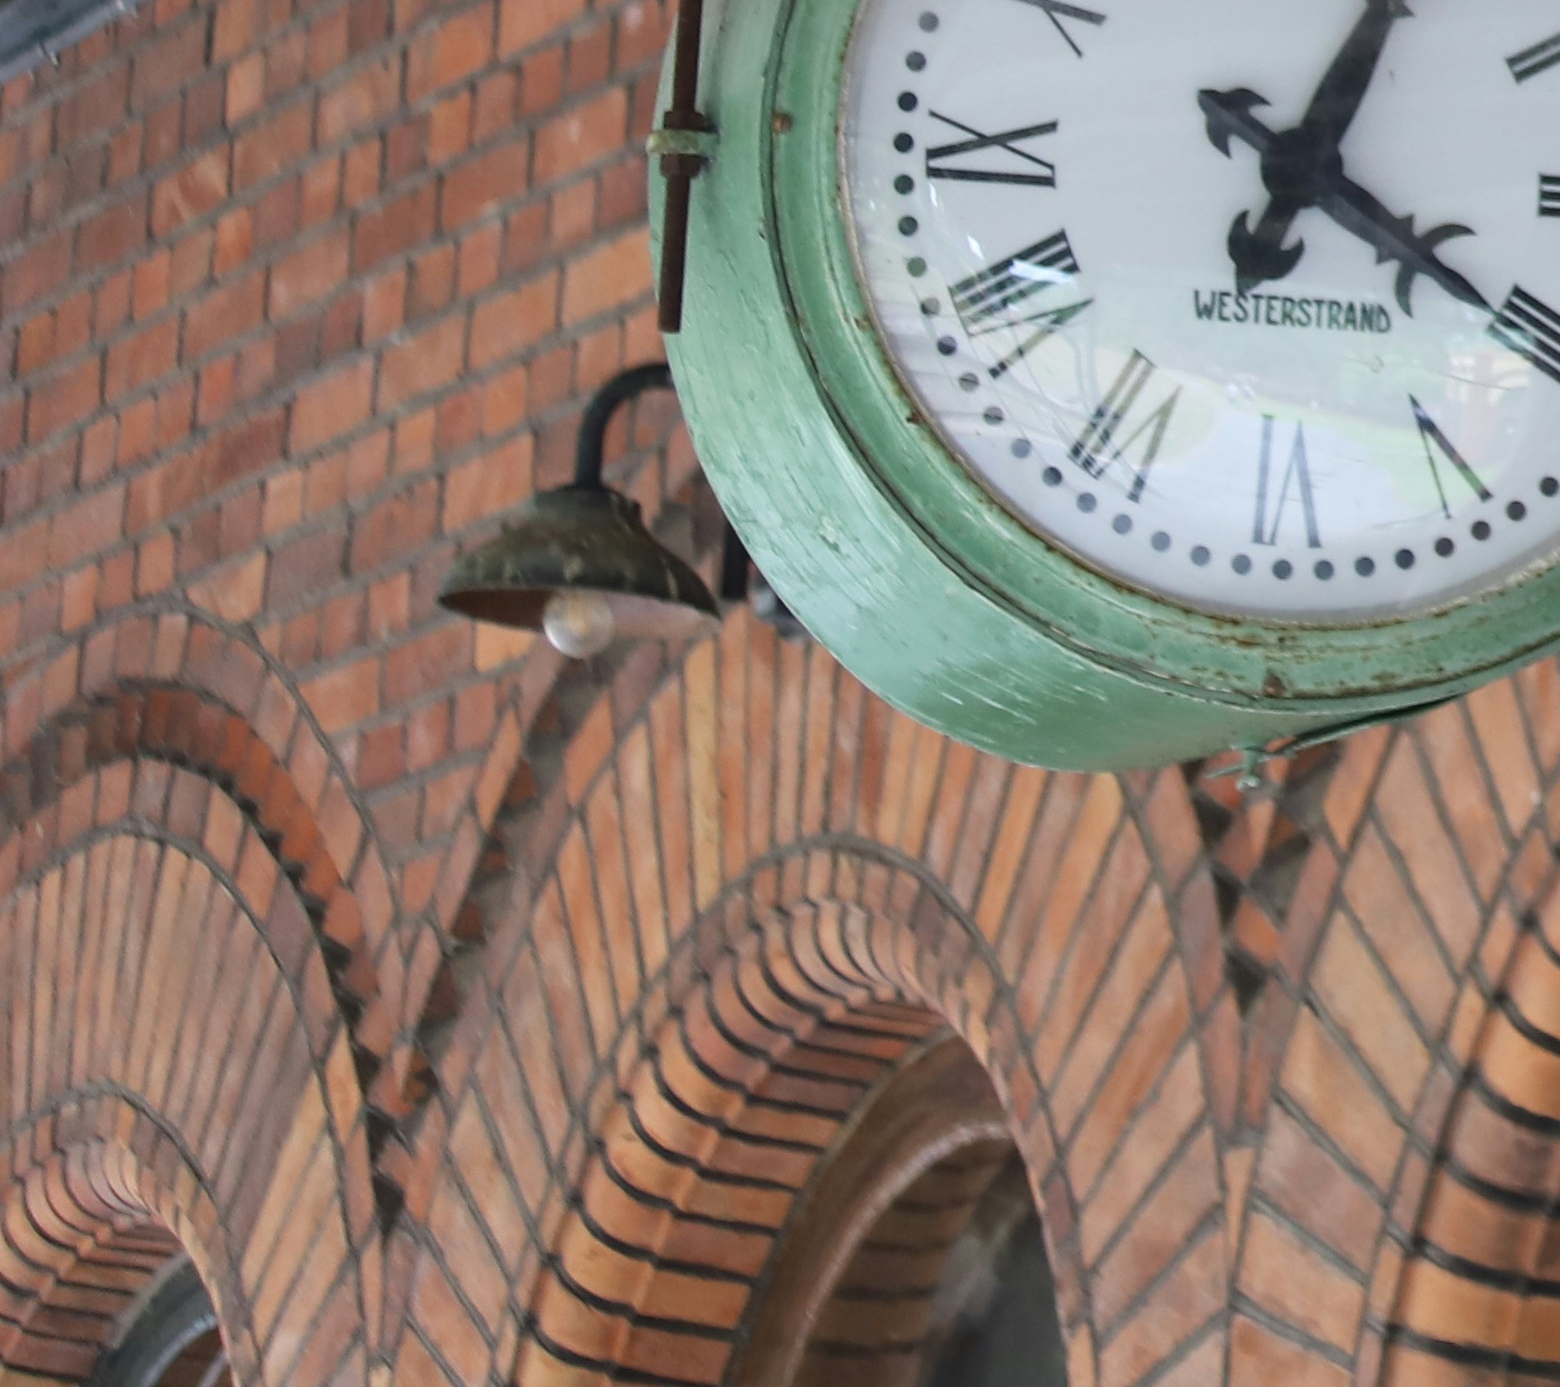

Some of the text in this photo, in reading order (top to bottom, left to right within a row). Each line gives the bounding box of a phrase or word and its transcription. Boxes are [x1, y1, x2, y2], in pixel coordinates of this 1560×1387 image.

[925, 110, 1058, 188] IX
[1193, 289, 1392, 333] WESTERSTRAND
[1252, 415, 1322, 548] VI
[1410, 395, 1493, 519] V
